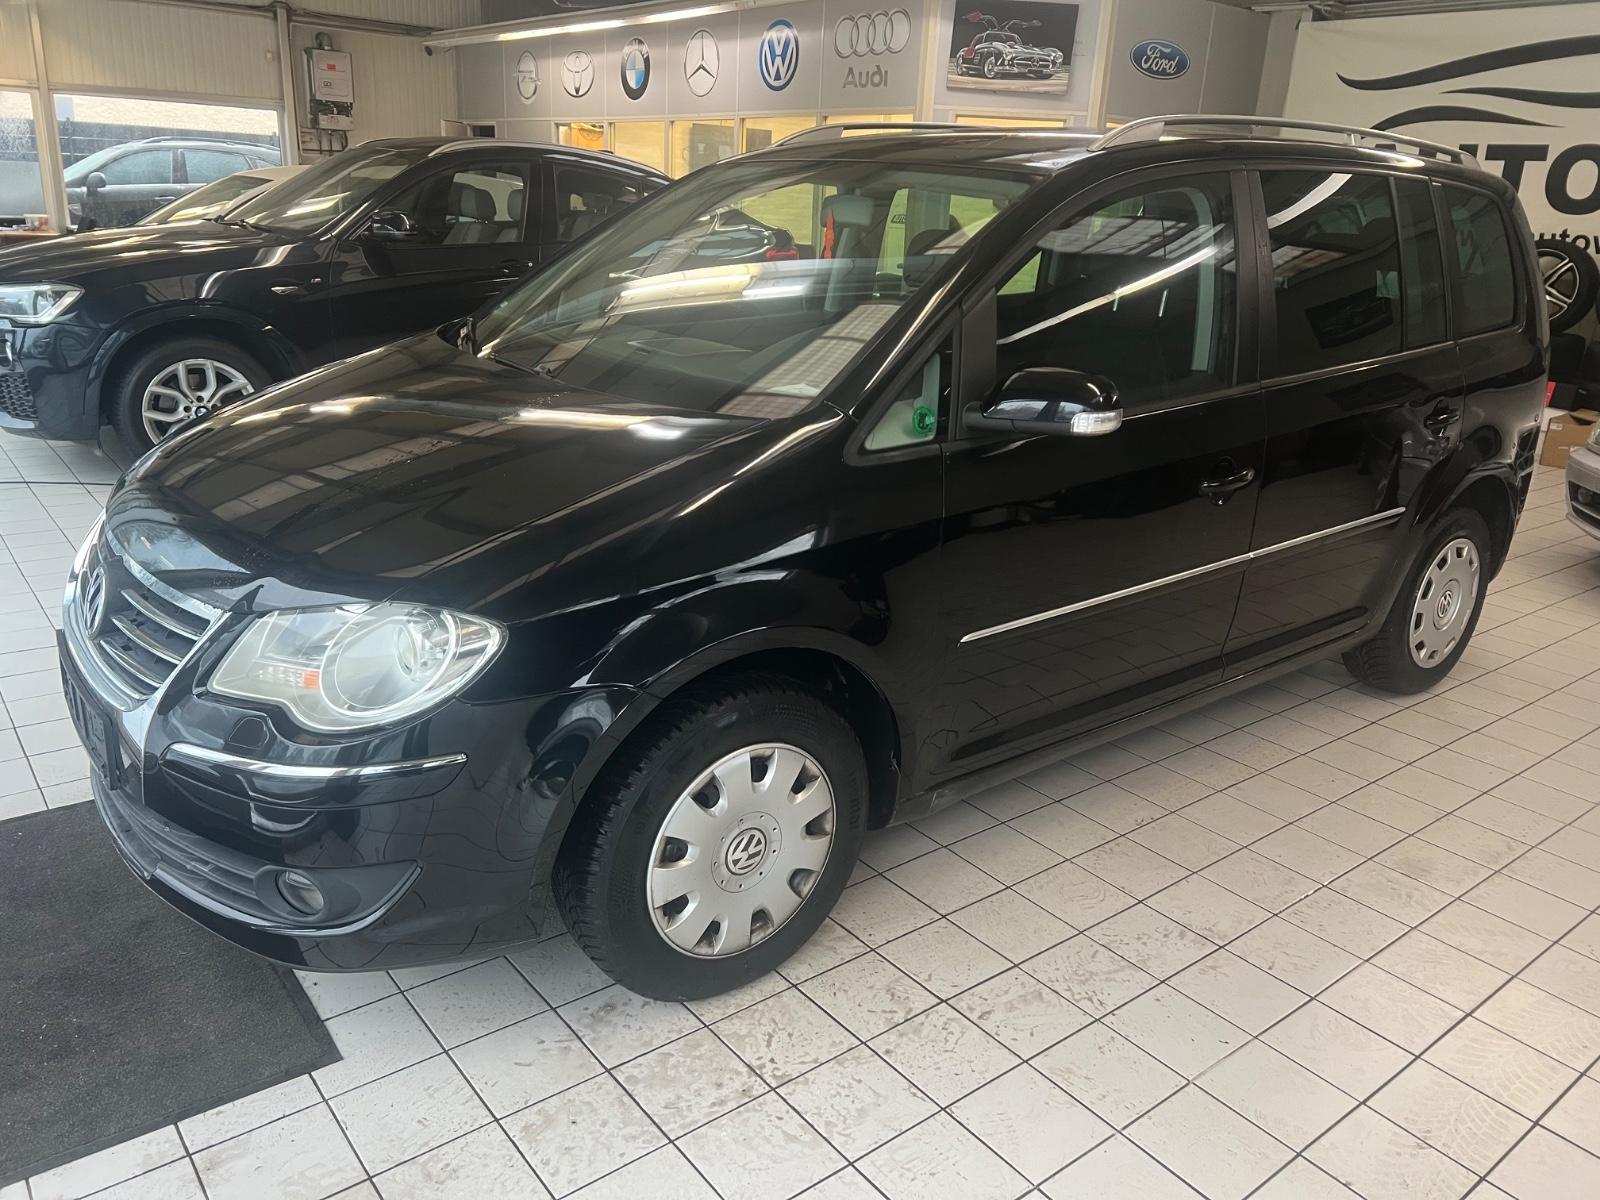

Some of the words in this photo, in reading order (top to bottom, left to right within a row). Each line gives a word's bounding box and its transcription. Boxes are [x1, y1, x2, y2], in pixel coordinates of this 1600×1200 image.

[1141, 43, 1180, 73] Ford
[842, 65, 888, 89] Audi
[1375, 144, 1600, 215] TO
